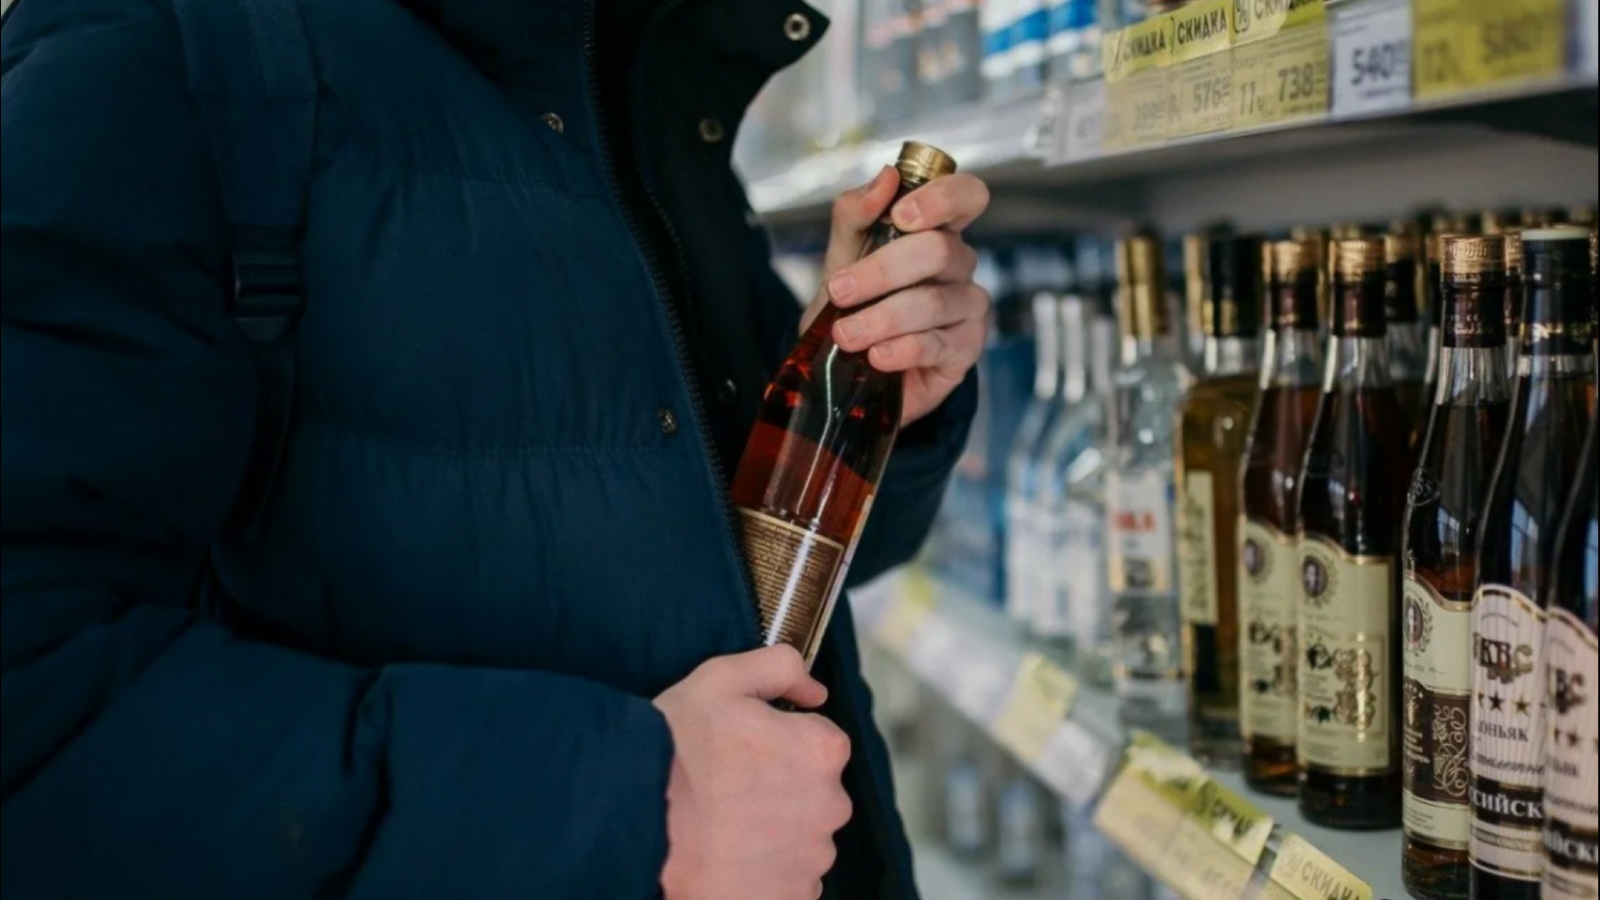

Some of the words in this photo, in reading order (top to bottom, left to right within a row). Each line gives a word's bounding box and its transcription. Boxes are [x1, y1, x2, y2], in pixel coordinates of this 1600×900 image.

[1177, 7, 1228, 45] СКИДКА
[1278, 62, 1316, 102] 738
[1351, 44, 1394, 86] 540
[1477, 720, 1530, 743] ОНЬЯК
[1469, 786, 1544, 819] СИЙСК
